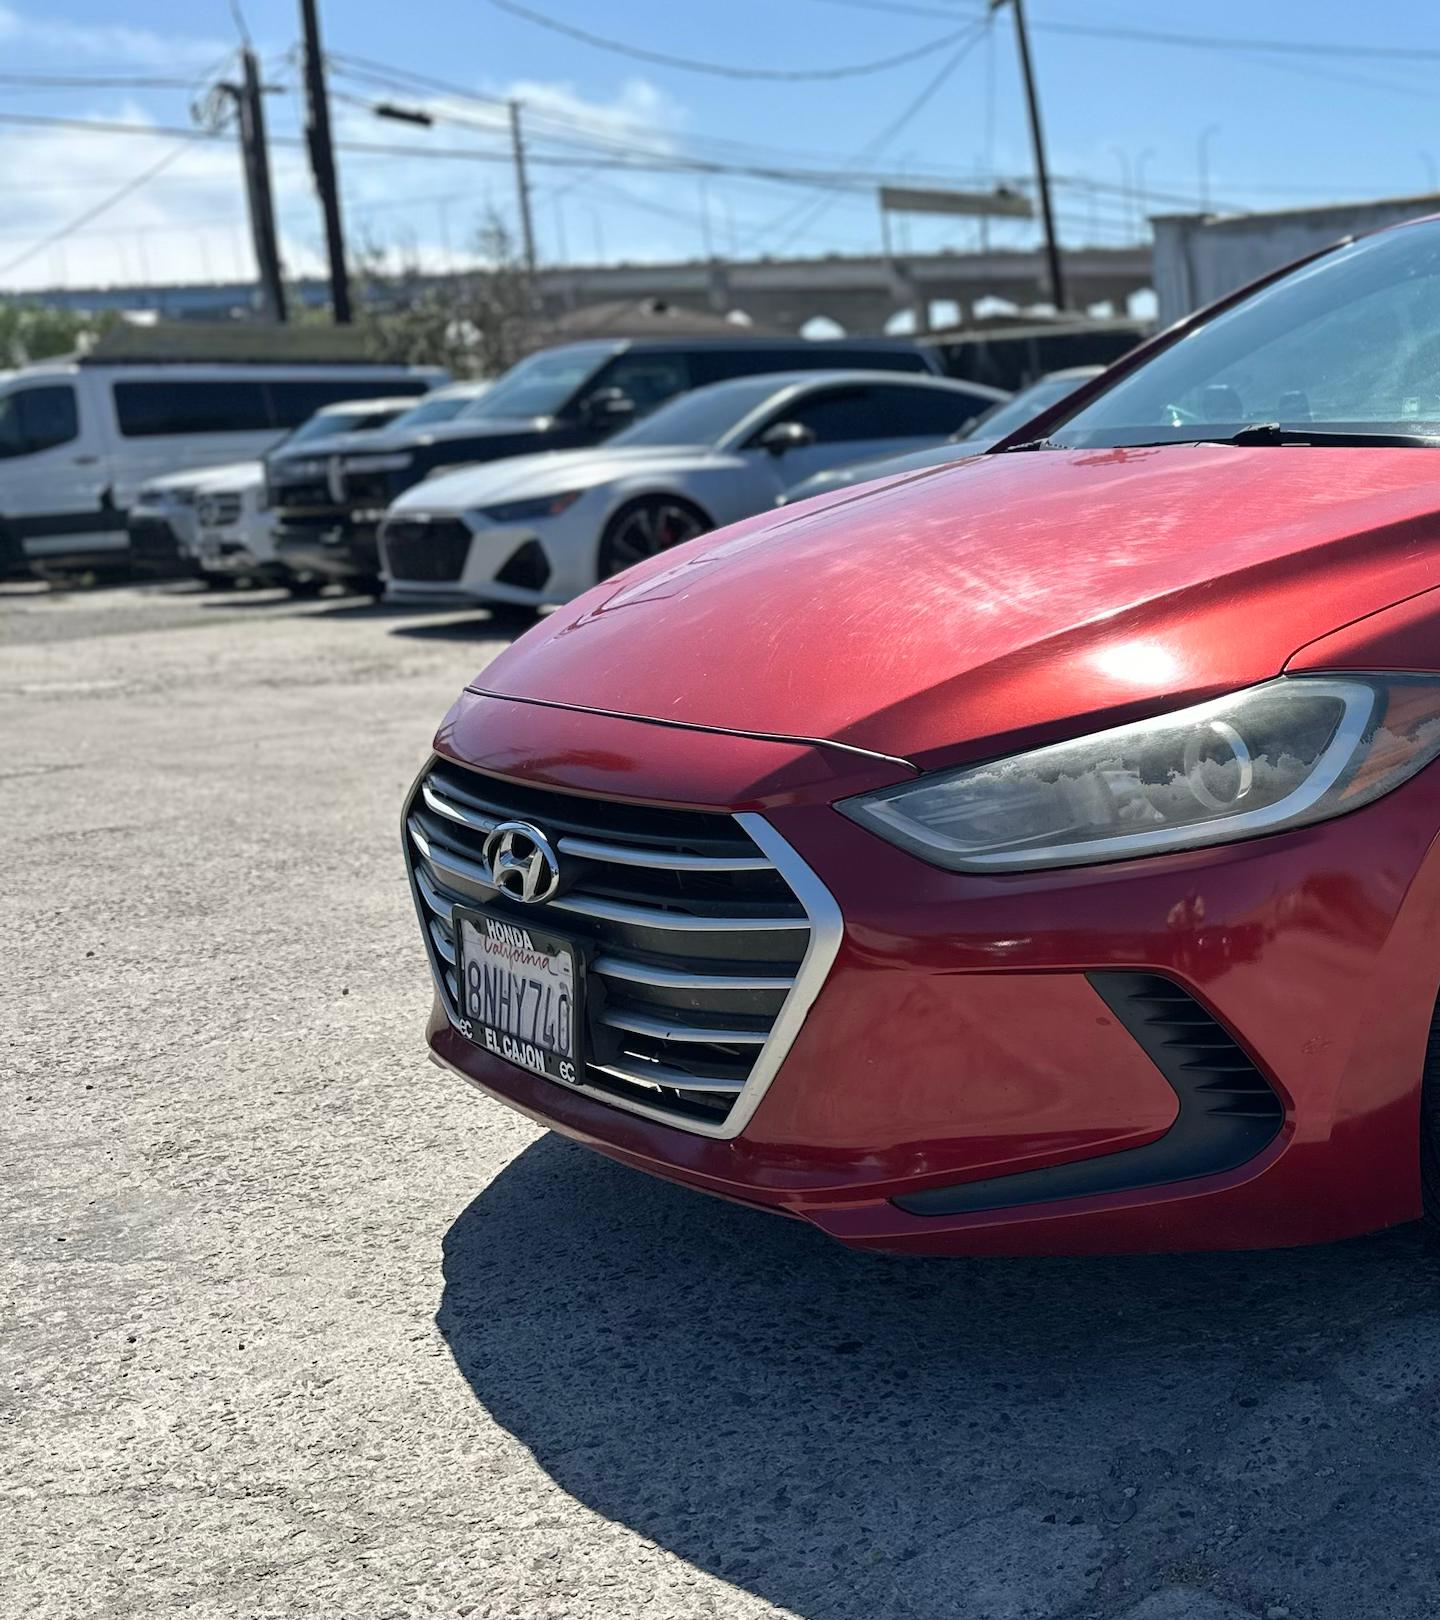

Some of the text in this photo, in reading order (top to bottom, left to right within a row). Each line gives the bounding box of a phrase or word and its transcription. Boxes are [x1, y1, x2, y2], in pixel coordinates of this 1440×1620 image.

[484, 935, 559, 977] California
[486, 918, 535, 952] HONDA
[484, 1027, 546, 1074] EL CAJON
